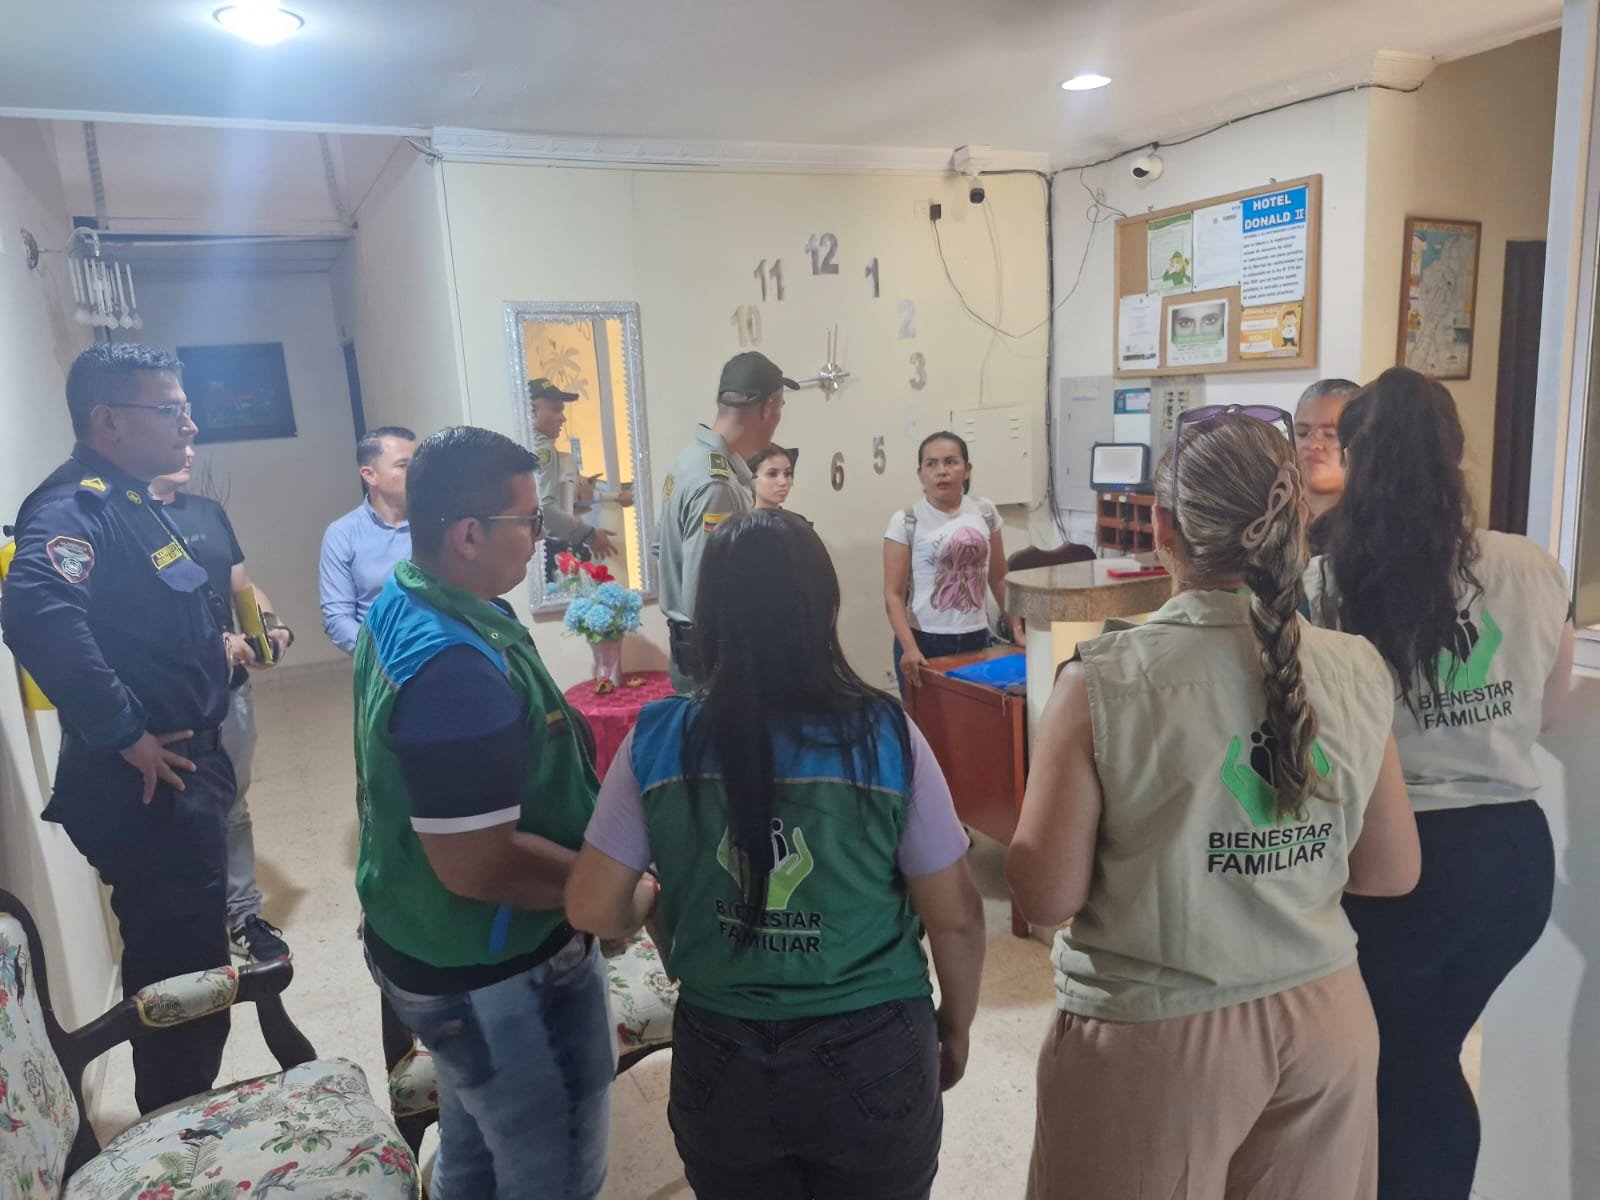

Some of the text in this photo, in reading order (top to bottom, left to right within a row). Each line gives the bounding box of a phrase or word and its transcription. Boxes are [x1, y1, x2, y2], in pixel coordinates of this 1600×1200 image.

[1244, 211, 1291, 230] DONALD
[1252, 193, 1292, 211] HOTEL
[804, 232, 839, 275] 12
[753, 258, 785, 302] 11
[865, 257, 880, 298] 1
[730, 304, 763, 348] 10
[897, 300, 917, 339] 2
[909, 352, 927, 391] 3
[830, 451, 845, 491] 6
[873, 435, 887, 475] 5
[1423, 700, 1513, 729] FAMILIAR
[1208, 823, 1333, 849] BIENESTAR
[1207, 842, 1326, 875] FAMILIAR
